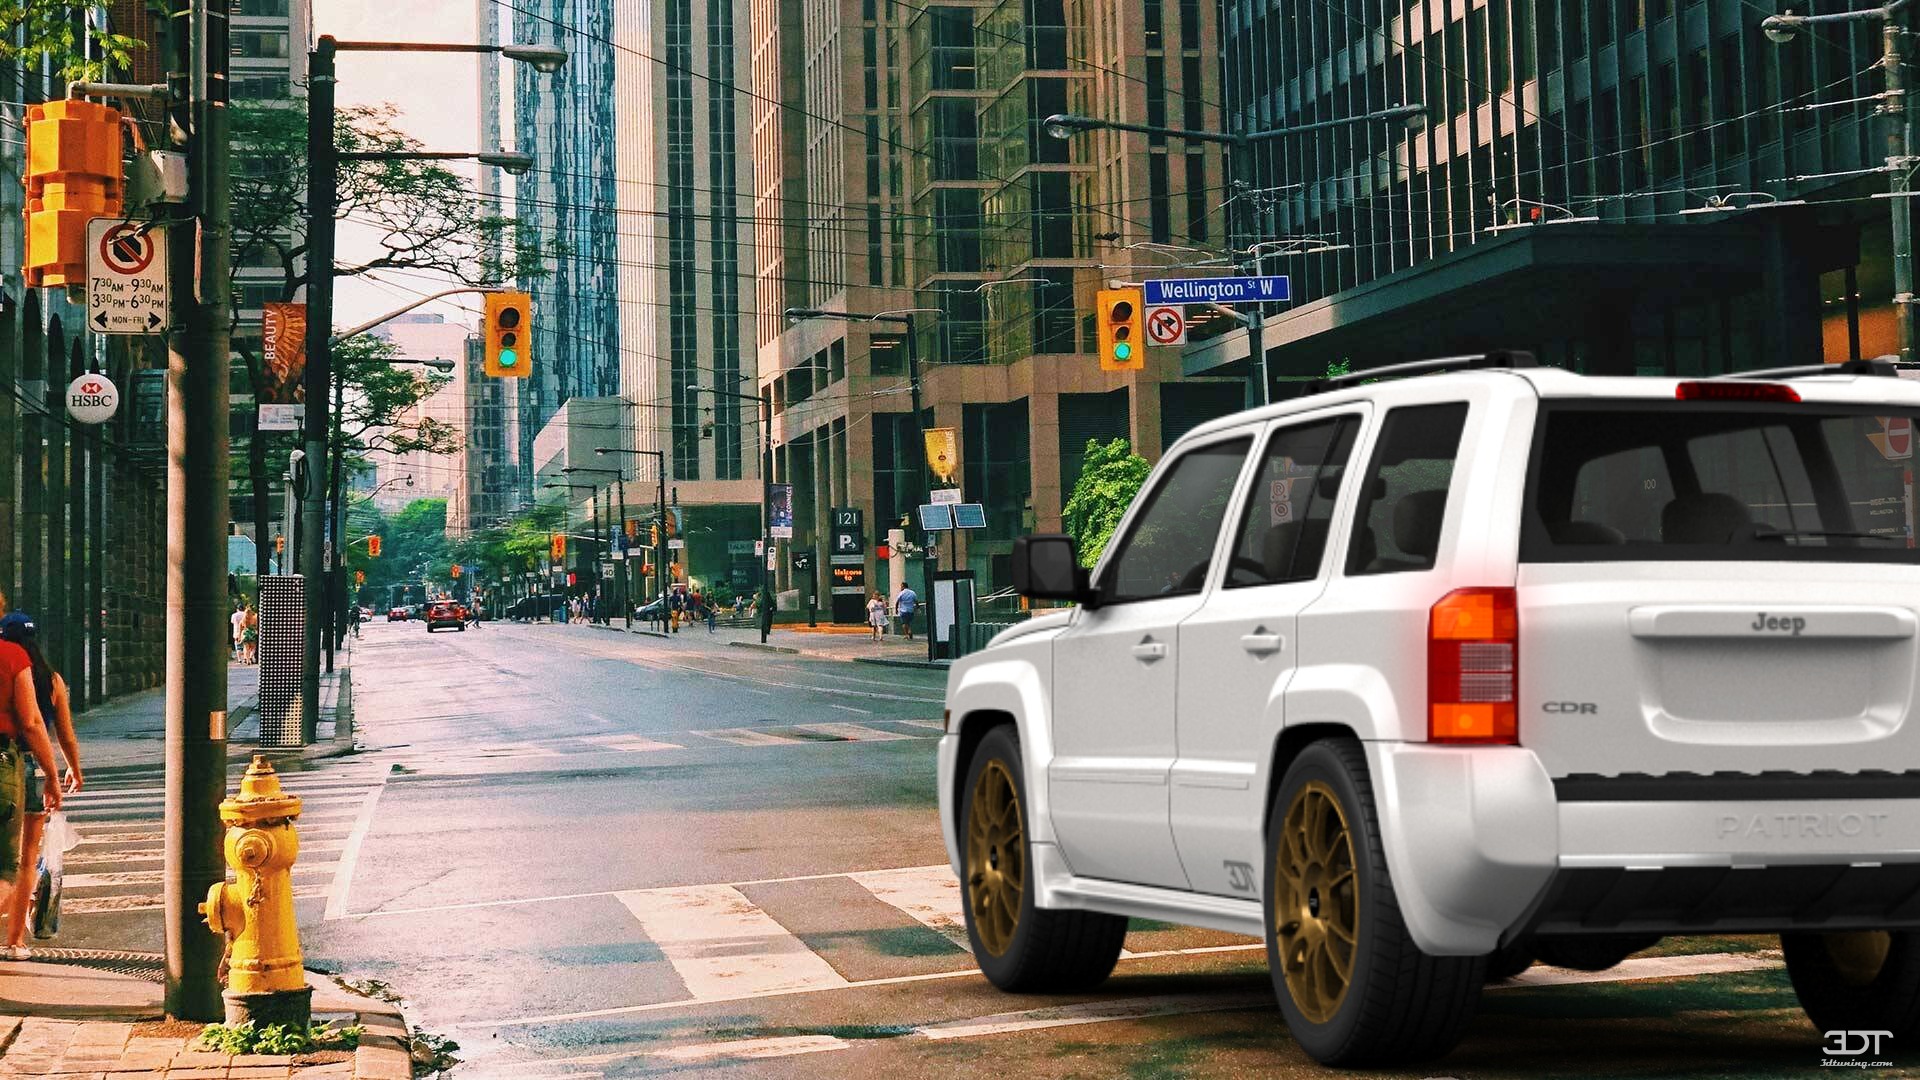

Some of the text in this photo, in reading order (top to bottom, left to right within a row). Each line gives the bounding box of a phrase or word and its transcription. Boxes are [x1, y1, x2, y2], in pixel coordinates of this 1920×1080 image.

[1160, 279, 1273, 300] Wellington St W
[264, 309, 278, 360] BEAUTY
[71, 395, 112, 407] HSBC
[839, 512, 856, 525] 121
[840, 534, 852, 549] P
[1751, 612, 1806, 636] Jeep
[1541, 701, 1598, 715] CDR
[1715, 812, 1889, 840] PATRIOT
